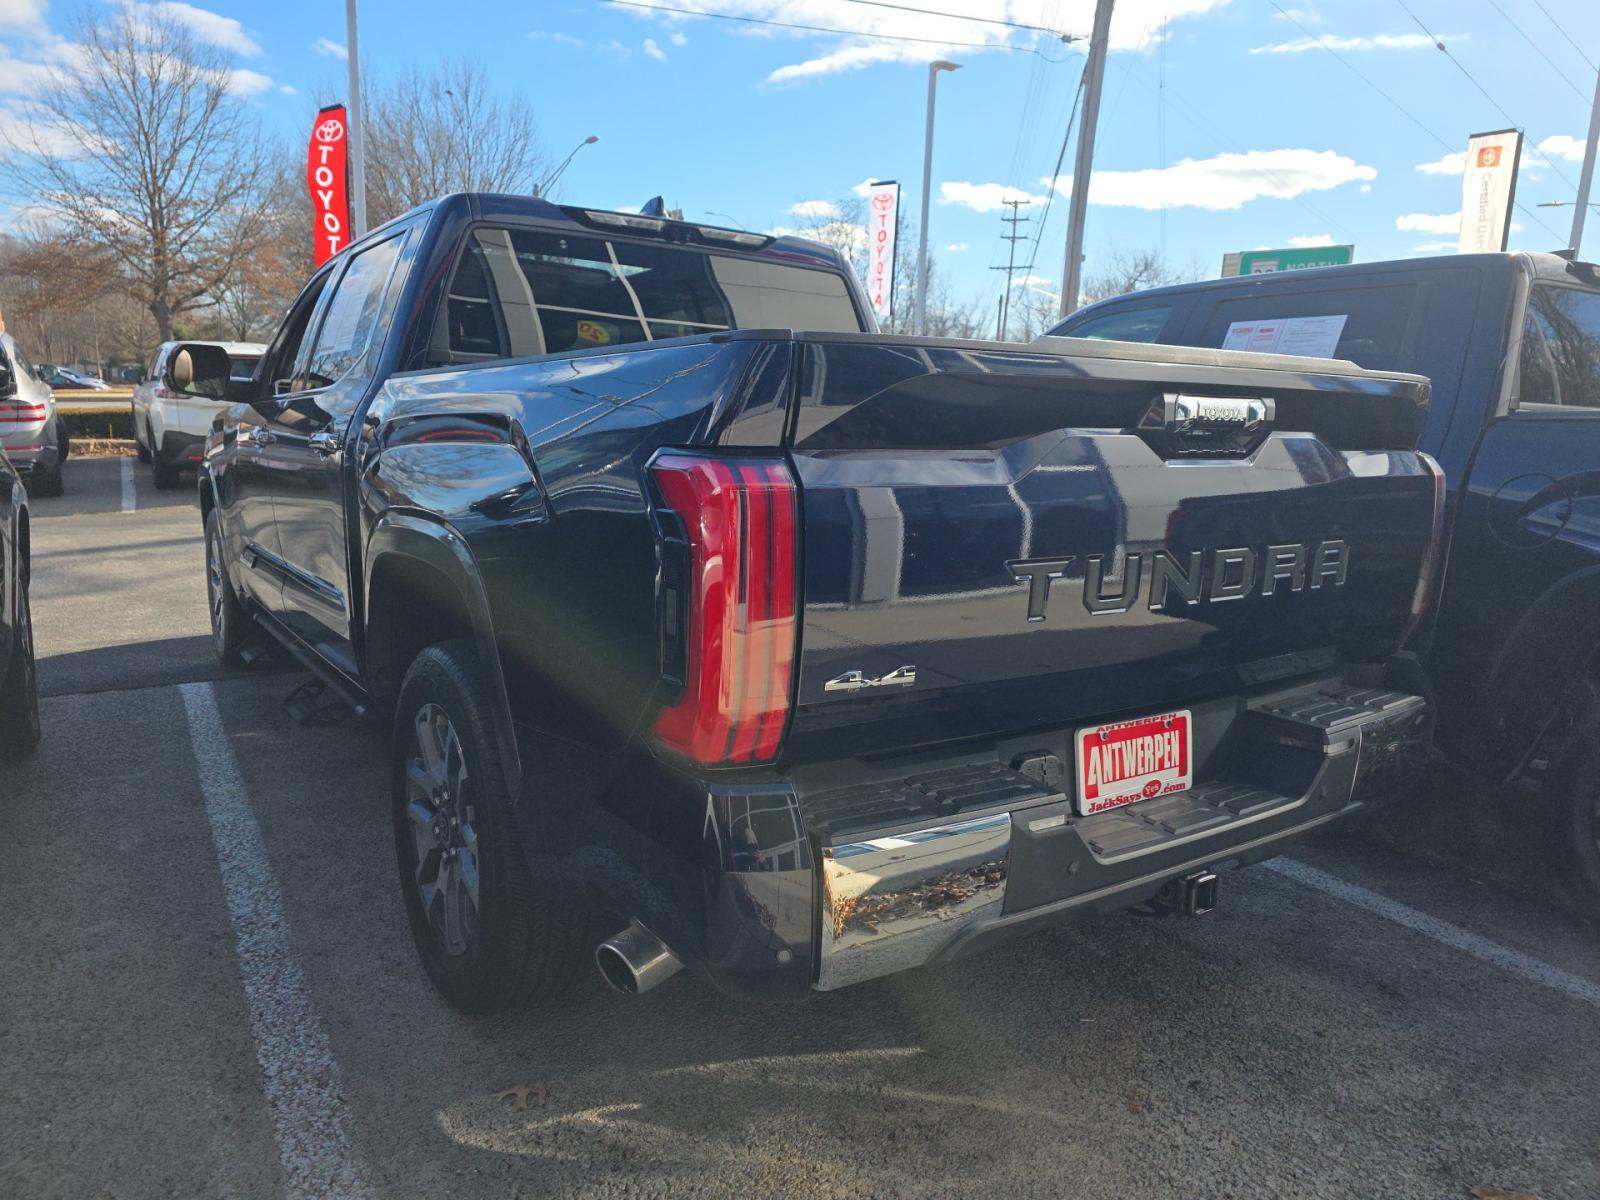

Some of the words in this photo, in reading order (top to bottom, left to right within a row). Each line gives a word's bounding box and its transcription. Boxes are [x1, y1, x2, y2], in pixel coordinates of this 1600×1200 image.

[315, 145, 341, 256] TOYOT
[875, 214, 887, 306] TOYOTA
[1203, 407, 1244, 421] TOYOTA
[1004, 540, 1351, 623] TUNDRA
[1096, 713, 1177, 732] ANTWERPEN
[1087, 730, 1180, 787] ANTWERPEN
